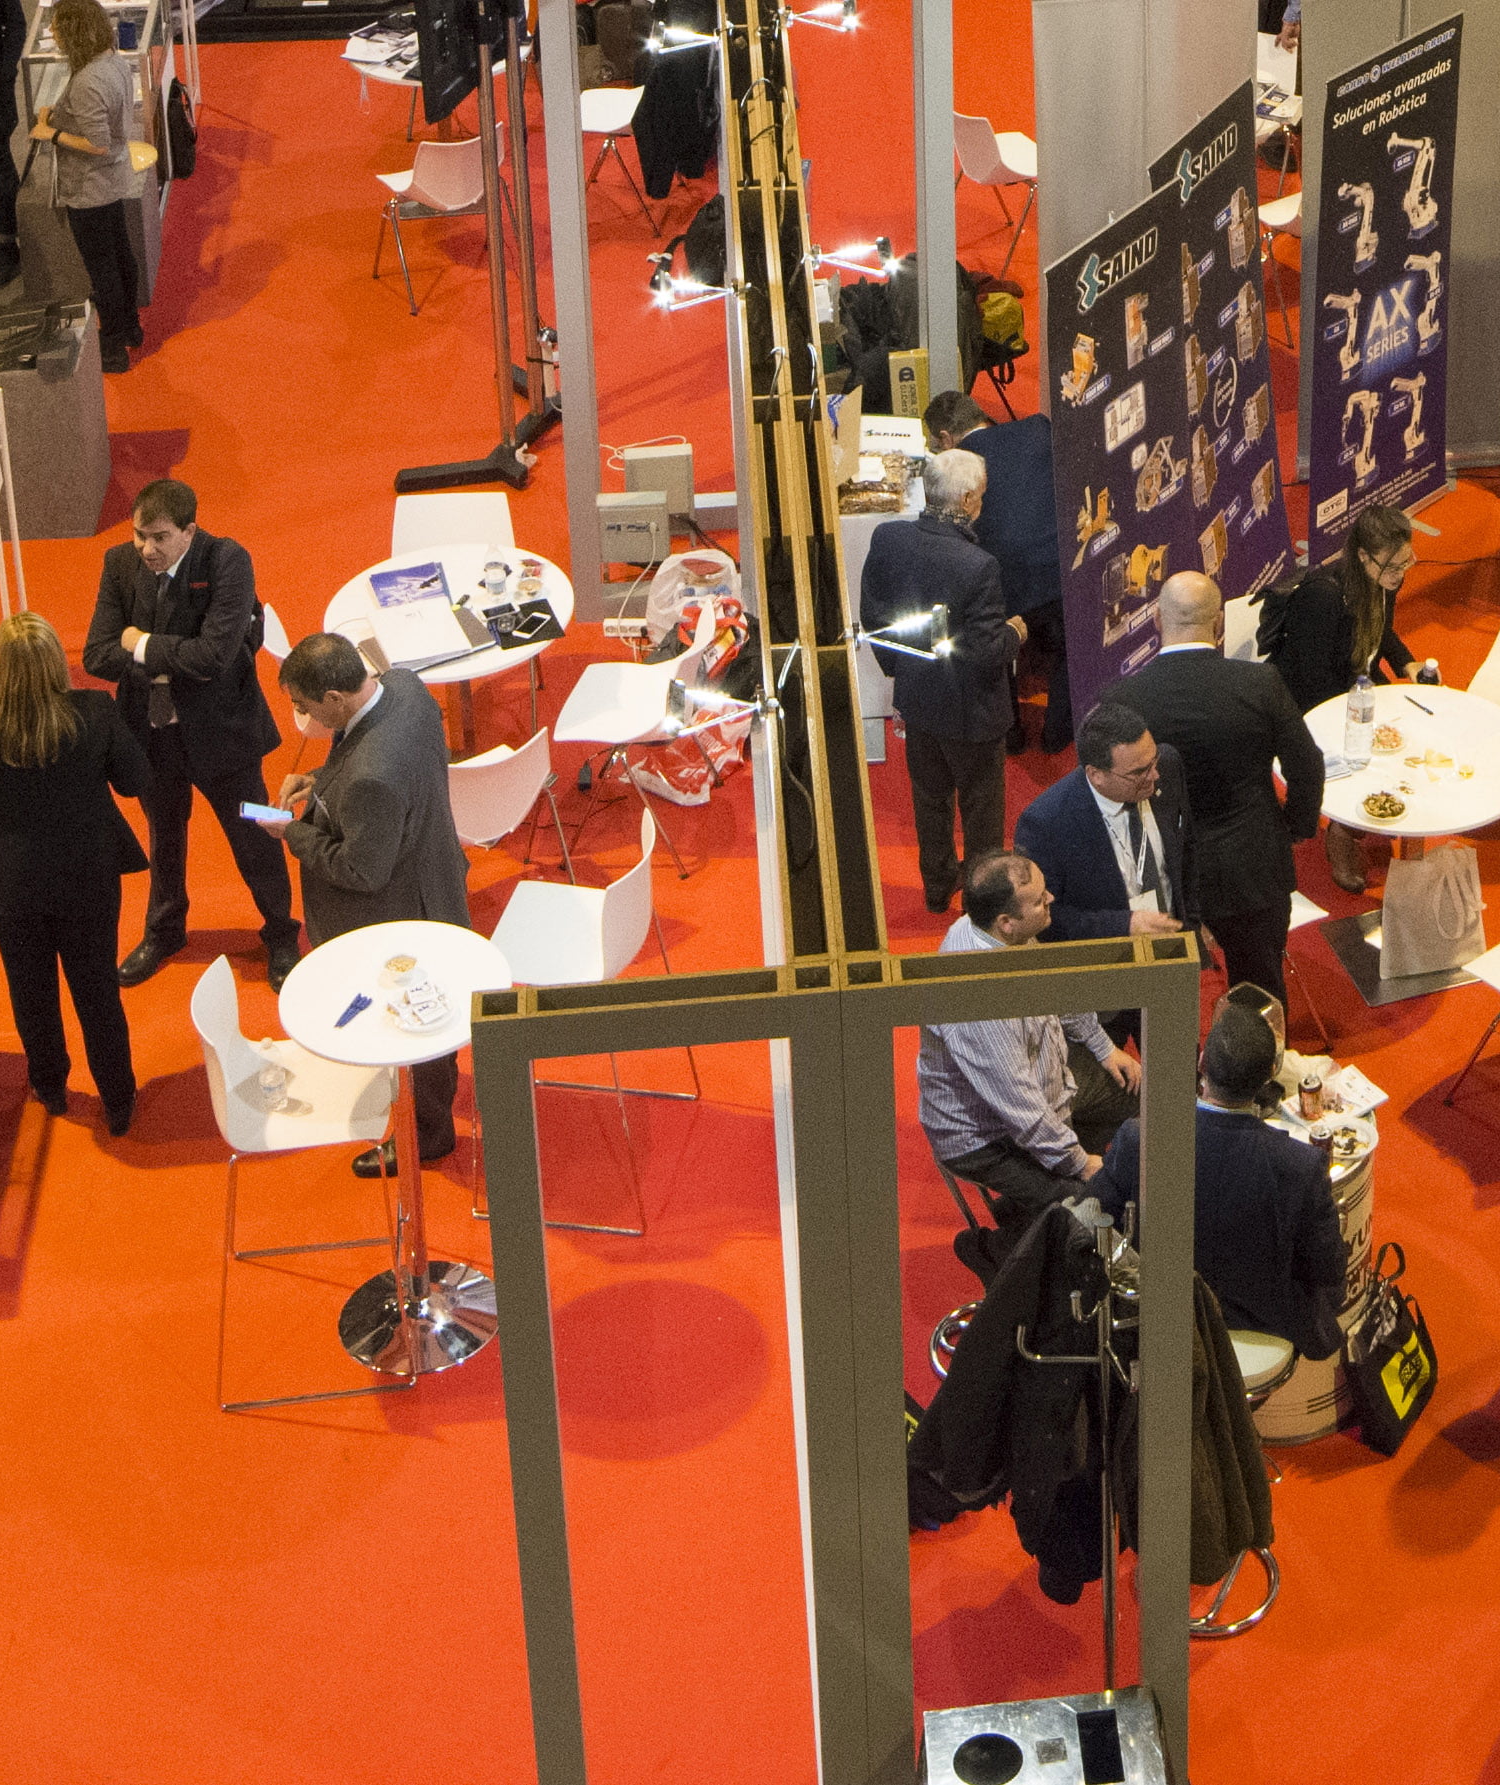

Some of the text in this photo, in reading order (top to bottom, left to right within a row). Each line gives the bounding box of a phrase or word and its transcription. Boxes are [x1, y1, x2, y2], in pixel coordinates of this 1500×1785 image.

[1332, 87, 1392, 130] Soluciones
[1393, 58, 1452, 99] avanzadas
[1362, 91, 1428, 136] en Robótica
[1188, 121, 1238, 189] SAIND
[1097, 226, 1159, 298] SAIND
[1370, 279, 1411, 334] AX
[1366, 329, 1409, 364] SERIES
